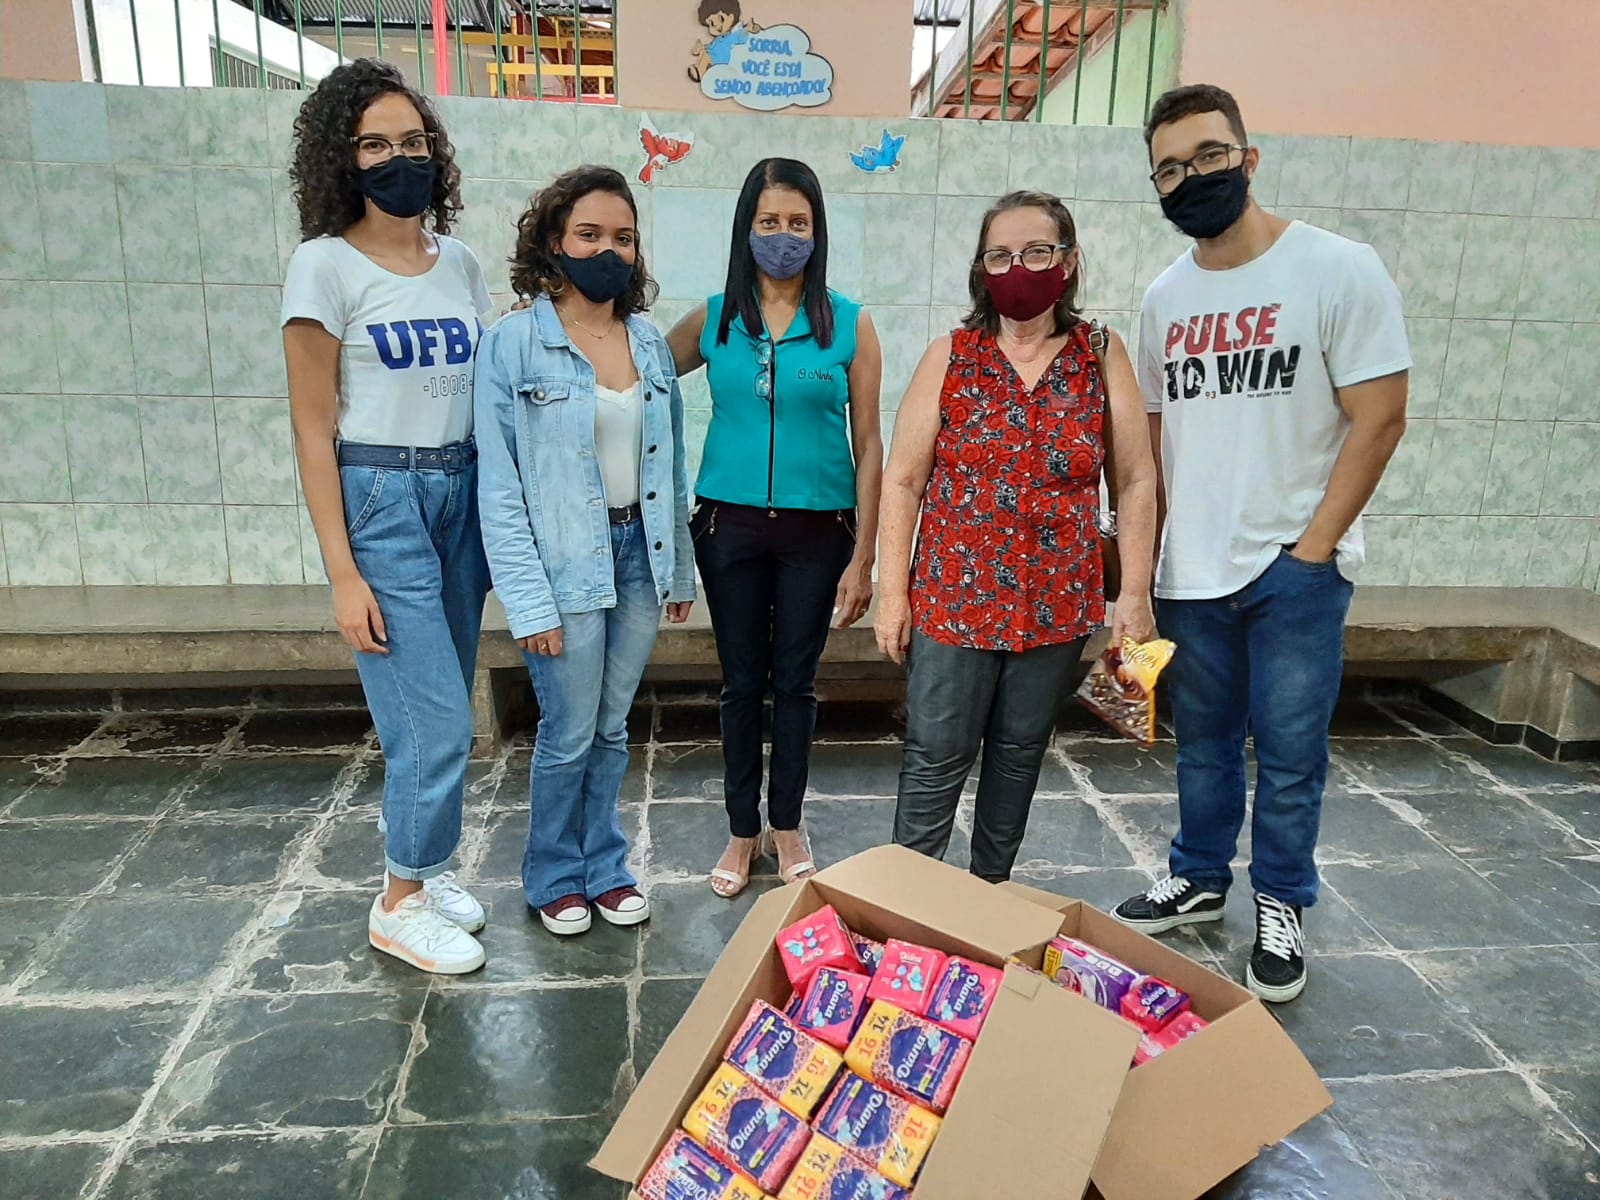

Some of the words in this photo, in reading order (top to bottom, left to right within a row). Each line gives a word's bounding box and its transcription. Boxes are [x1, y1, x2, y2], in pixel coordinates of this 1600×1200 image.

[741, 59, 770, 76] VOCÊ
[714, 78, 752, 94] SENDO
[1165, 303, 1282, 359] PULSE
[1164, 357, 1206, 402] TO
[1217, 344, 1302, 395] WIN
[824, 979, 848, 1019] Diana
[953, 974, 980, 1013] Diana
[1141, 987, 1167, 1006] Diana
[872, 1014, 890, 1033] 14
[759, 1030, 792, 1071] Diana
[859, 1037, 877, 1057] 16
[896, 1034, 927, 1079] Diana
[806, 1055, 825, 1076] 16
[790, 1077, 809, 1097] 14
[851, 1093, 884, 1139] Diana
[730, 1107, 767, 1151] Diana
[903, 1117, 923, 1139] 16
[811, 1151, 832, 1173] 14
[796, 1176, 817, 1200] 16
